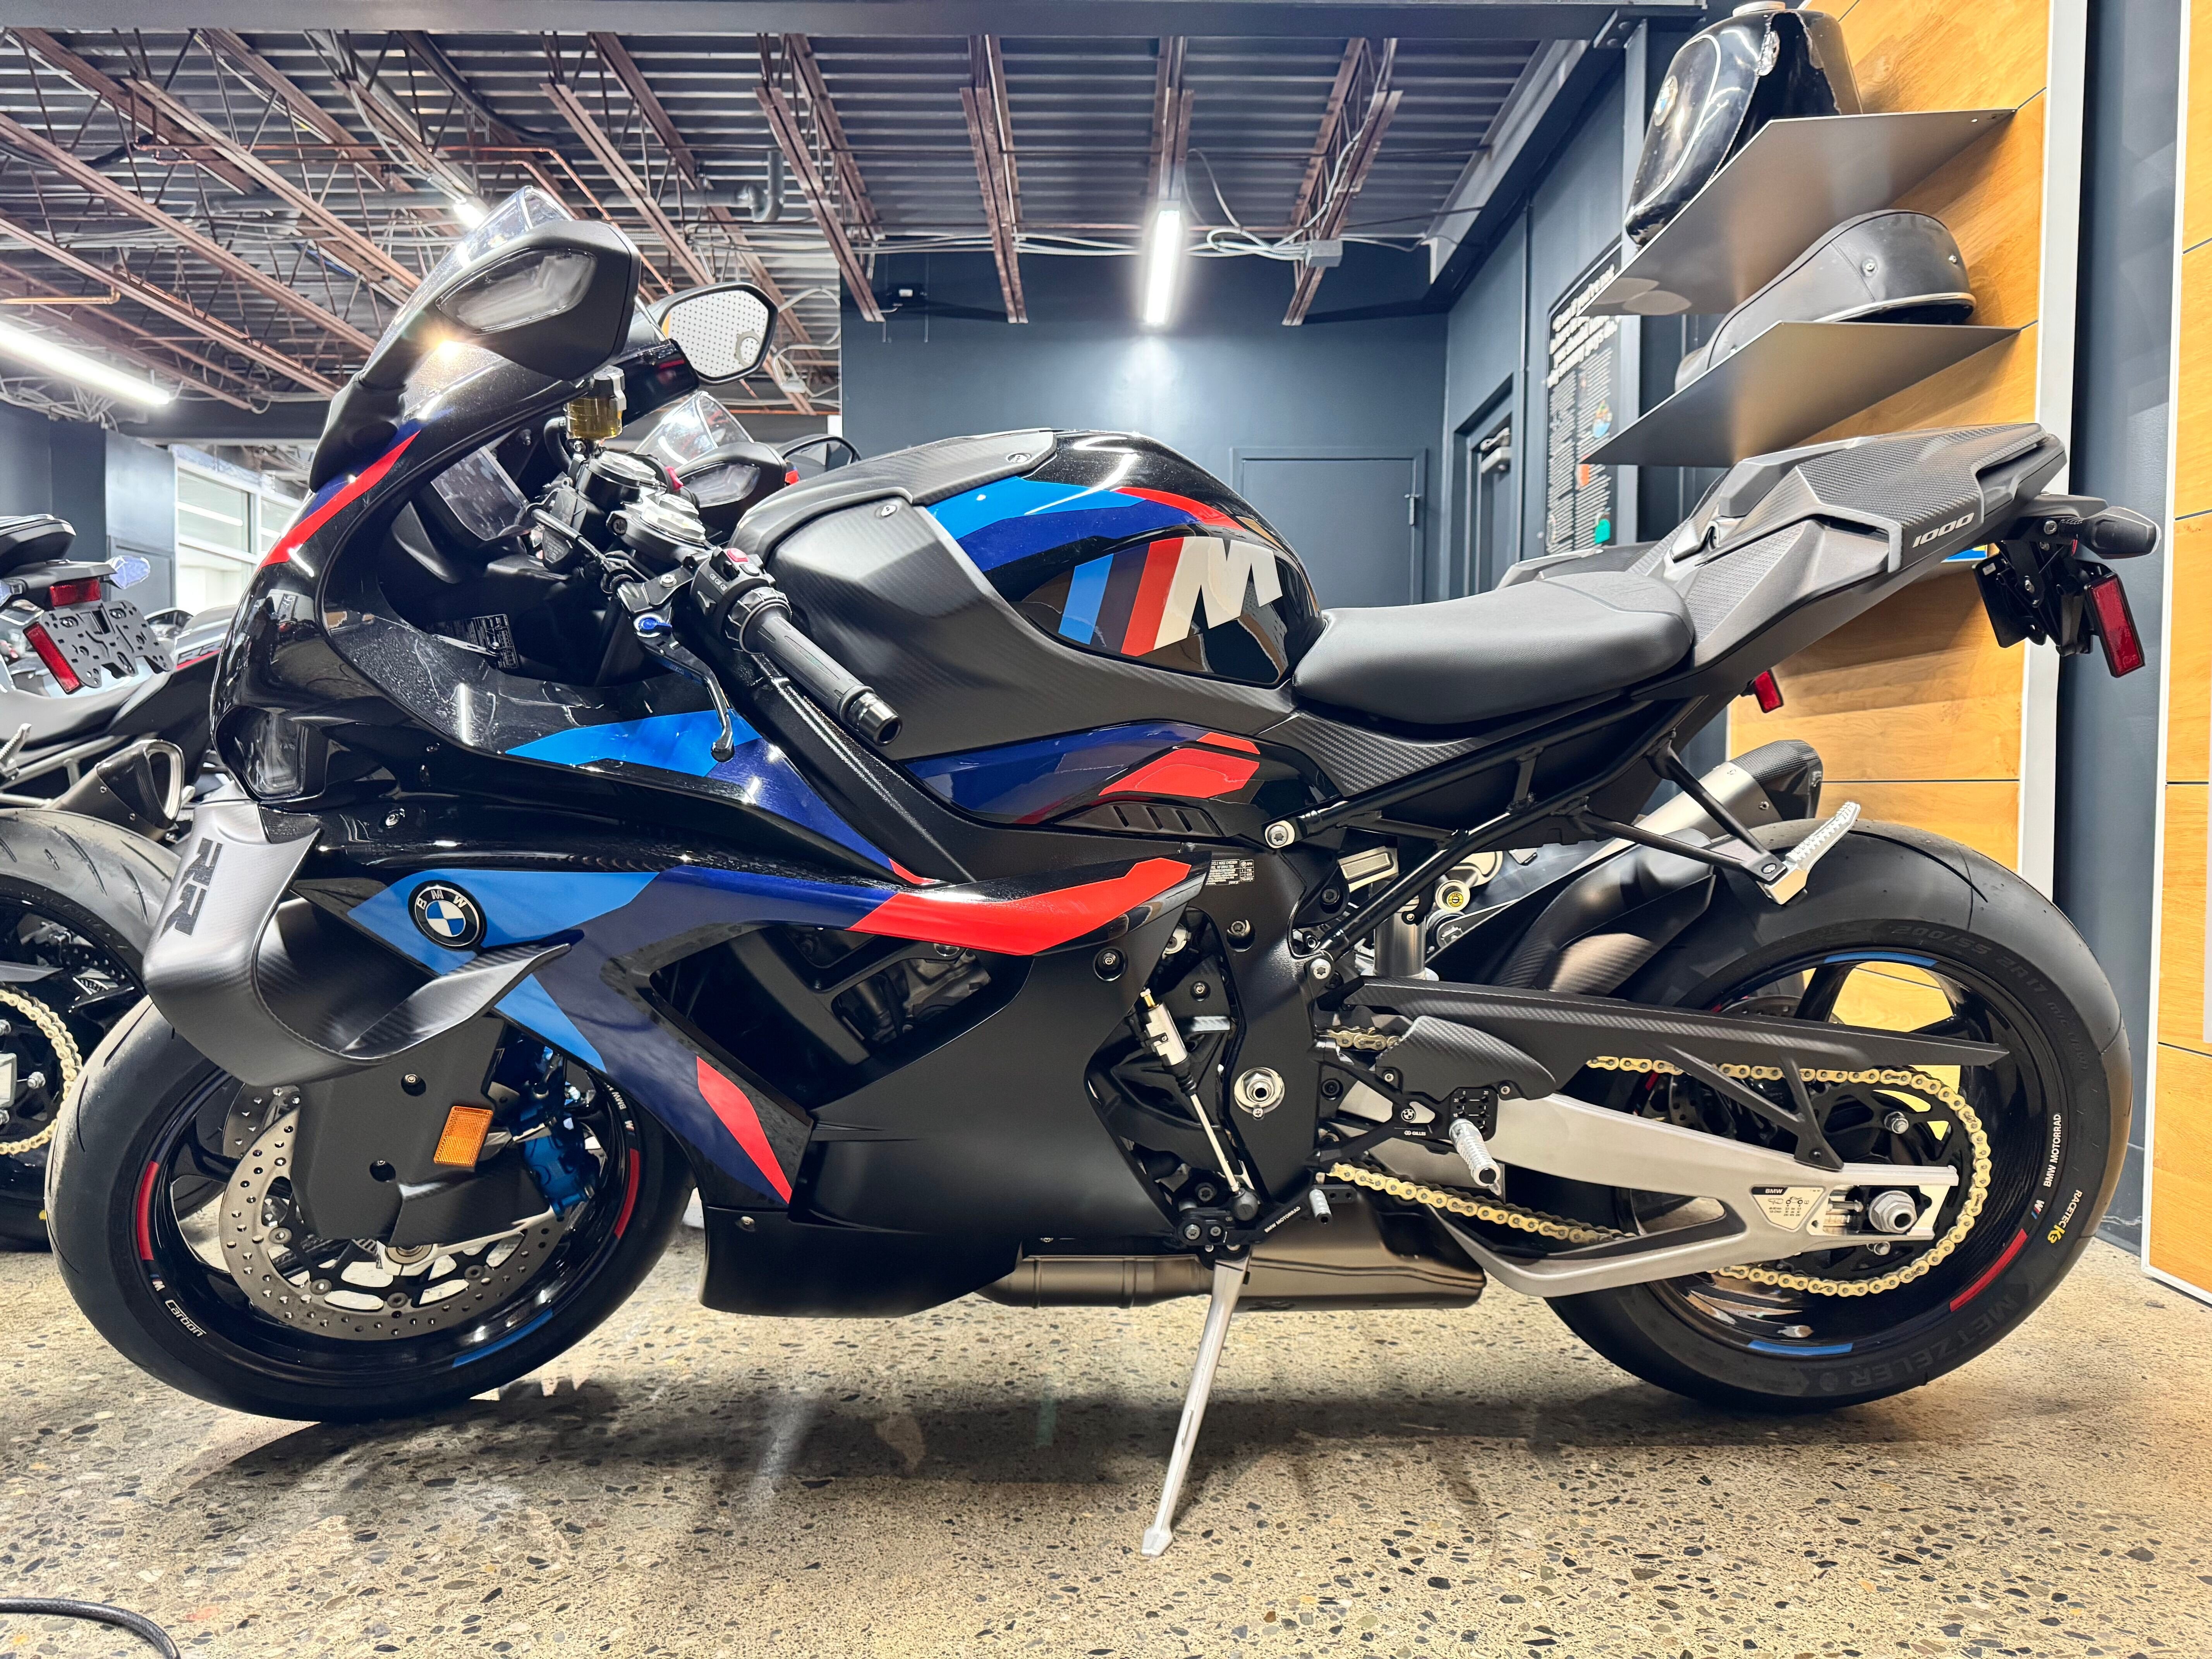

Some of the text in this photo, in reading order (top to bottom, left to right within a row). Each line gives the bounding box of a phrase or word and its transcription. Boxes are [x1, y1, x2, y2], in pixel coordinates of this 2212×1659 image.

[1912, 512, 1975, 548] 1000
[1154, 537, 1283, 651] M
[158, 837, 223, 937] RR
[417, 889, 467, 910] BMW
[2043, 1113, 2062, 1187] BMW MOTORRAD
[1276, 1206, 1301, 1225] MOTORRAD
[2047, 1190, 2083, 1244] RACETEC K3
[165, 1299, 207, 1337] Carbon
[1850, 1299, 2020, 1387] METZELER
